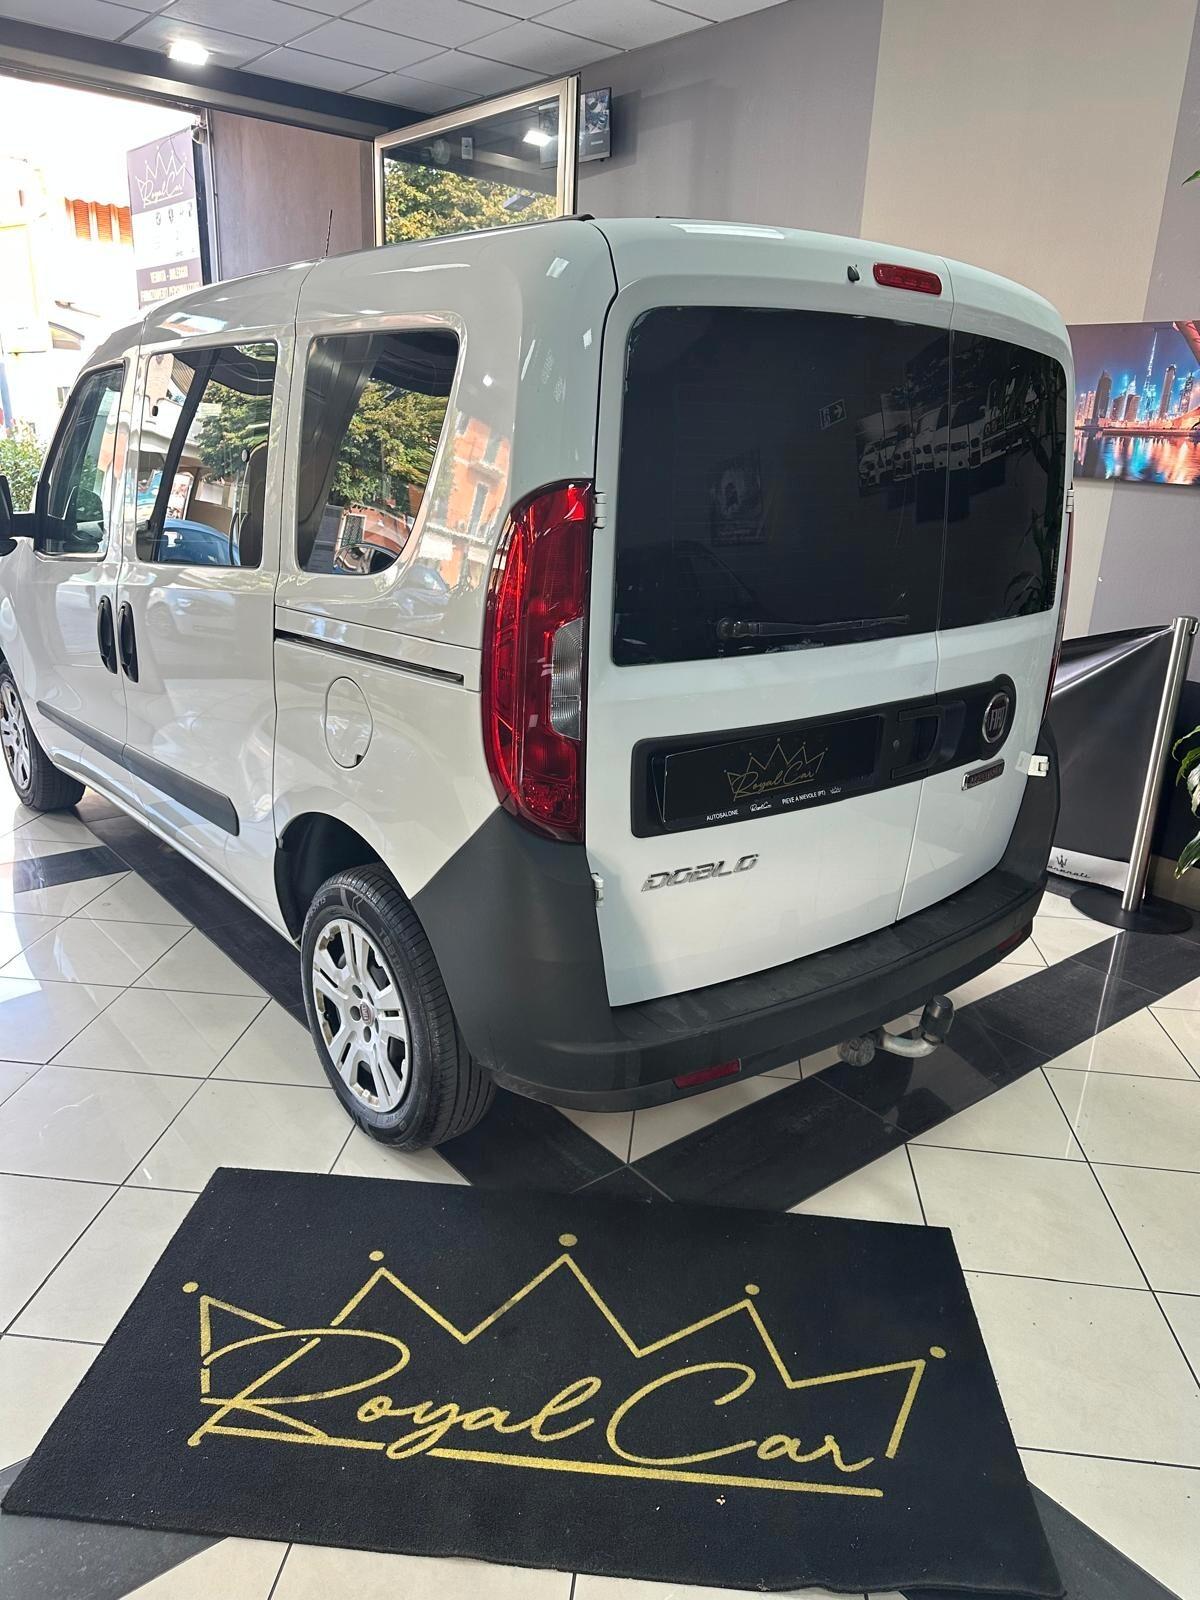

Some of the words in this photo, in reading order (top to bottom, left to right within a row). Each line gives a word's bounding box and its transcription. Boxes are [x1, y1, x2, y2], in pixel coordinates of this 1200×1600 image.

[731, 770, 784, 802] Royal
[783, 760, 815, 785] Car
[706, 809, 739, 821] AUTOSALONE
[781, 796, 795, 805] PIEVE
[187, 1327, 602, 1460] Royal
[606, 1361, 875, 1473] Car
